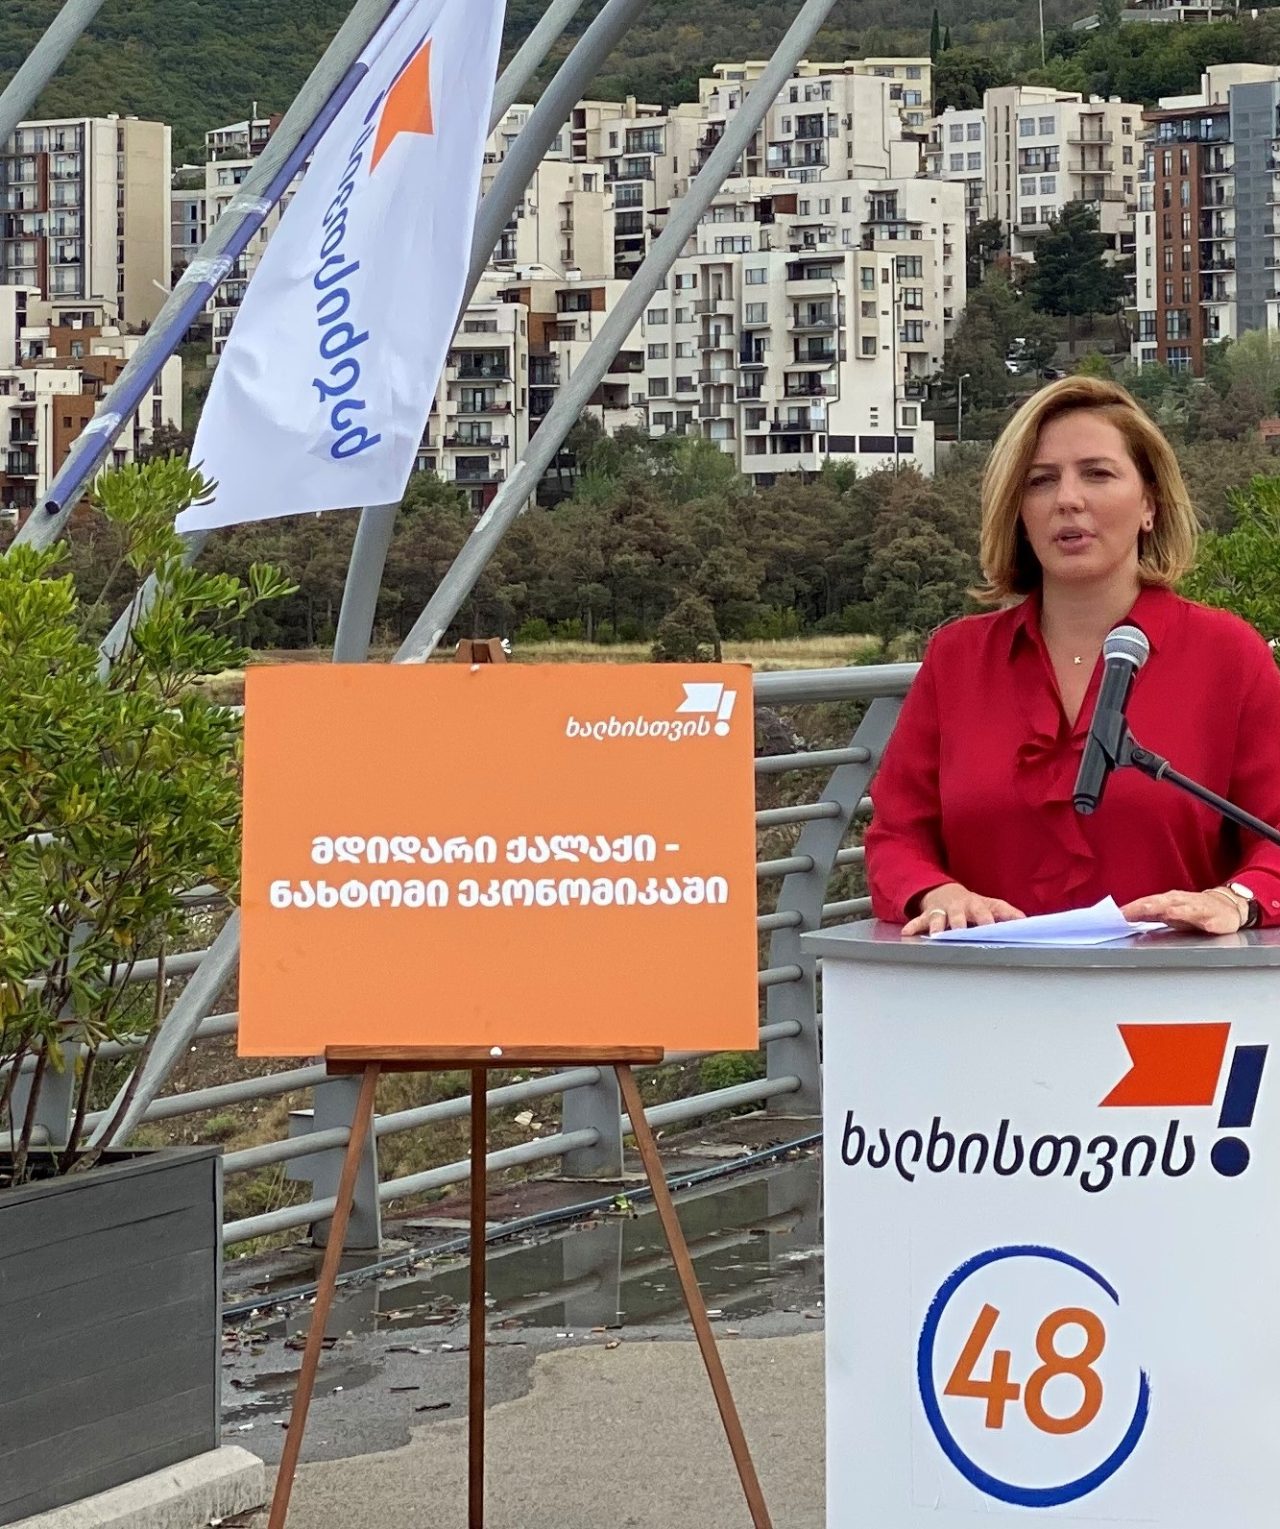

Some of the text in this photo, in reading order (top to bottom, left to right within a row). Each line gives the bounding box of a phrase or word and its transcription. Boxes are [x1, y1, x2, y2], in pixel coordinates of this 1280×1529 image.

[311, 835, 498, 865] მდიდარი
[505, 834, 658, 864] ქალაქი
[269, 875, 729, 909] ნახტომი ეკონომიკაში
[943, 1303, 1106, 1435] 48
